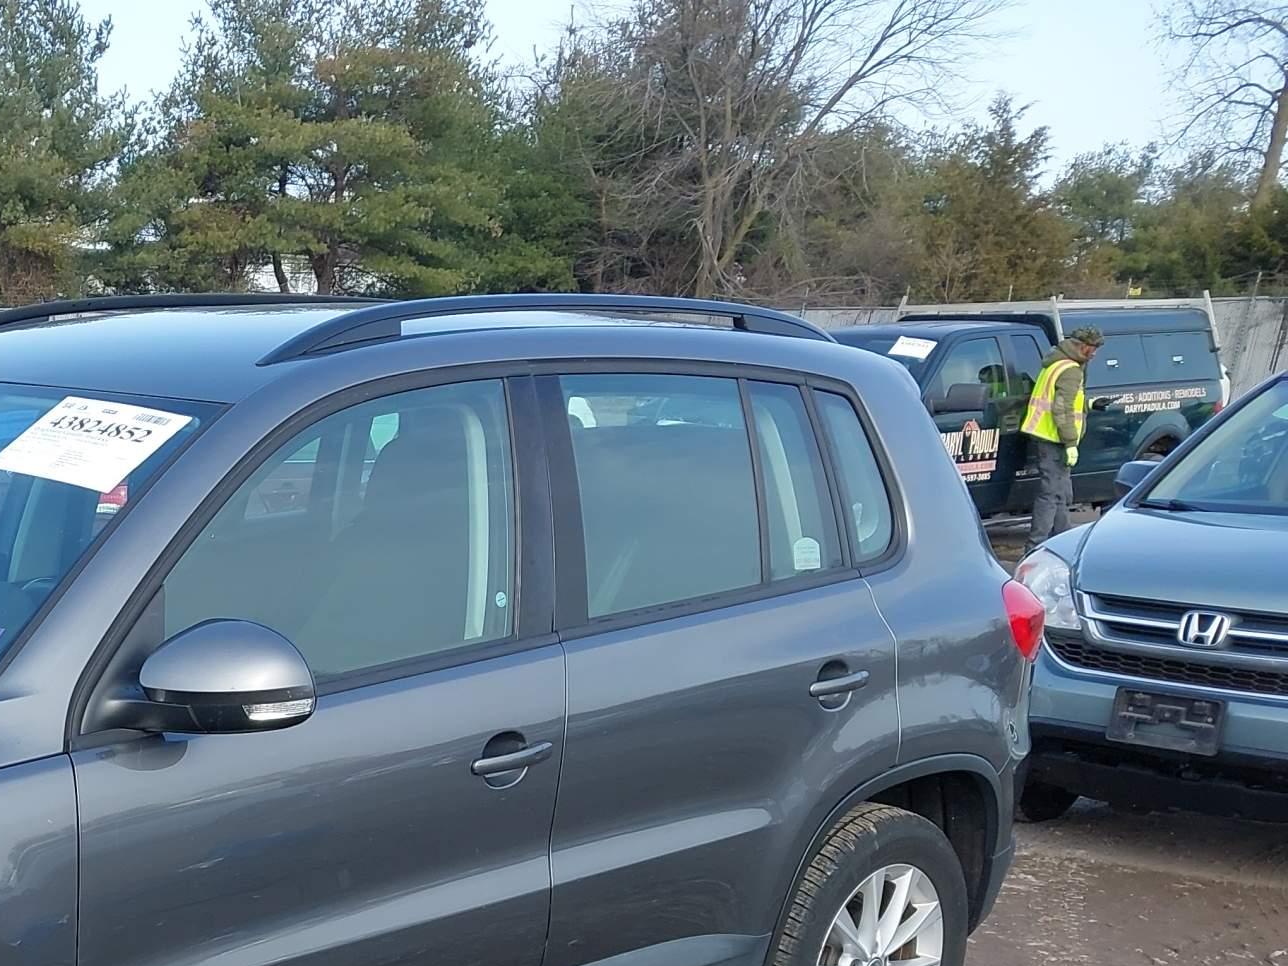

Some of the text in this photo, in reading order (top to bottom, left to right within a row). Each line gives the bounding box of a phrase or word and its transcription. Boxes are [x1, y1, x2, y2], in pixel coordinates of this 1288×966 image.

[1138, 390, 1172, 402] ADDITIONS
[1174, 387, 1207, 399] REMODELS
[1124, 400, 1181, 414] DARYLPADULA.COM
[50, 415, 153, 443] 43824852
[968, 429, 1000, 454] PADULA
